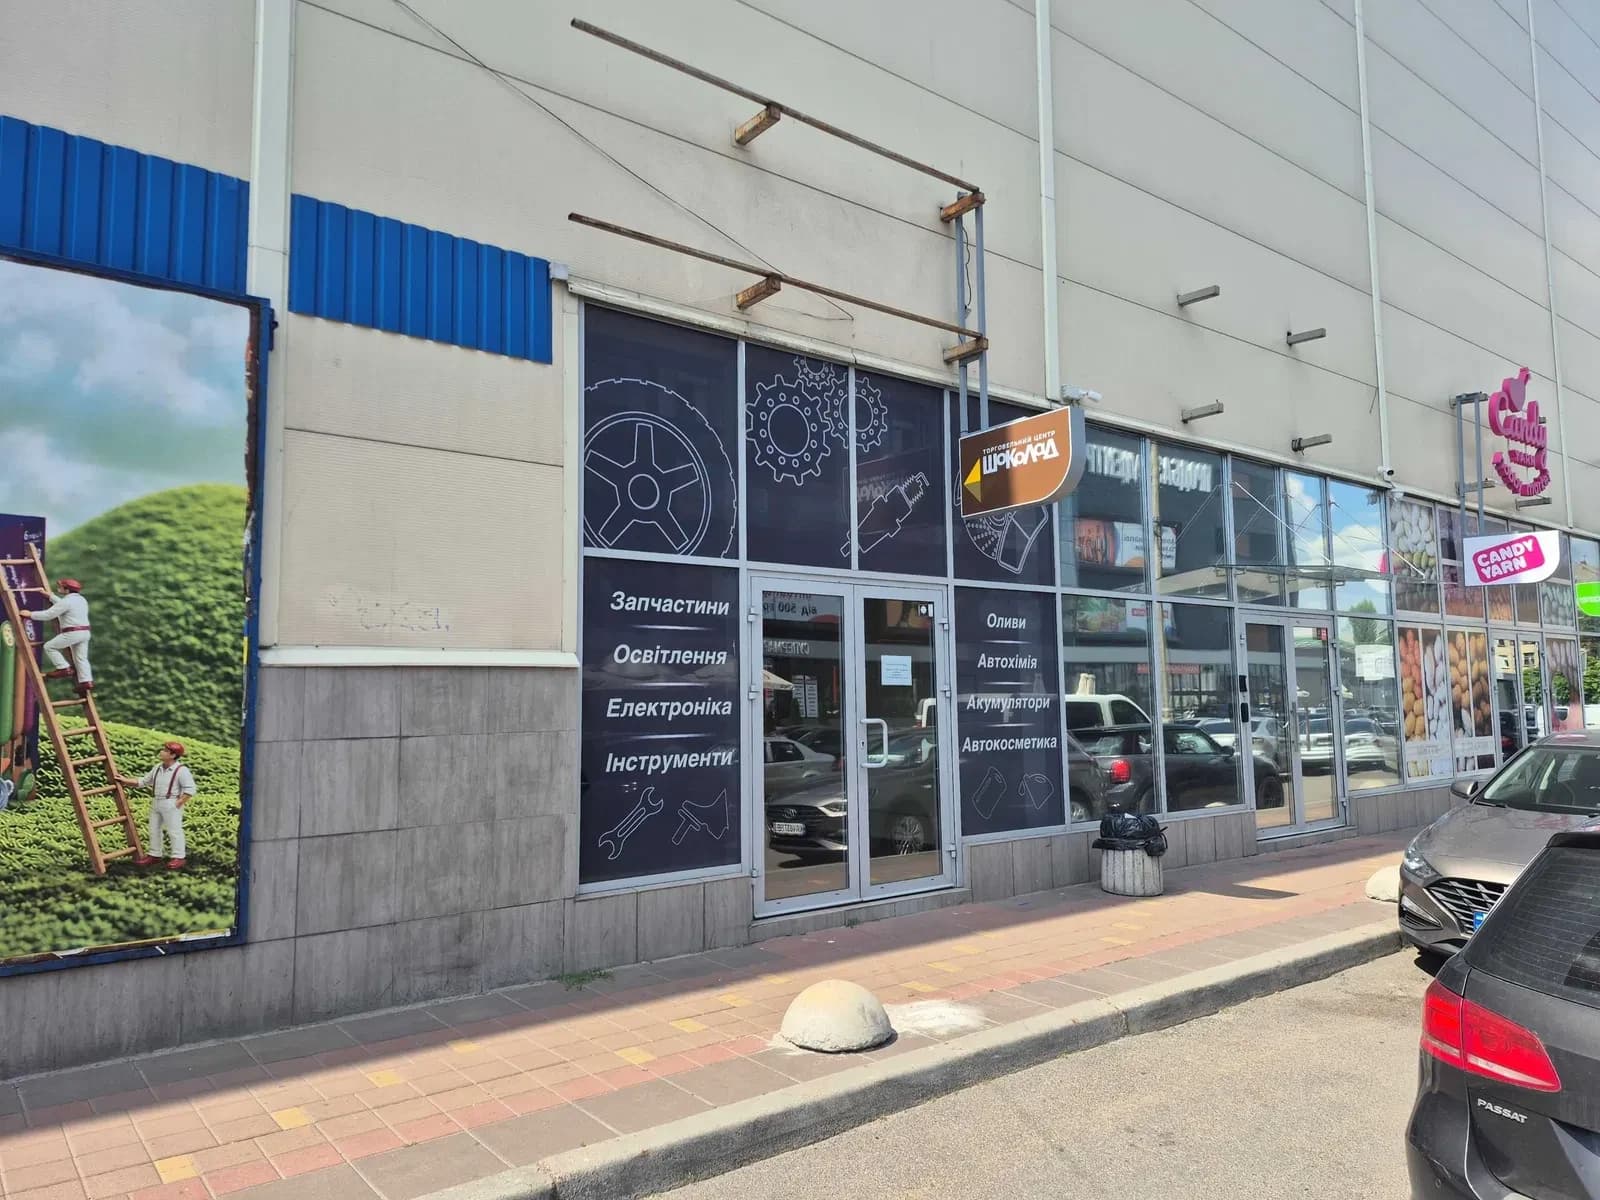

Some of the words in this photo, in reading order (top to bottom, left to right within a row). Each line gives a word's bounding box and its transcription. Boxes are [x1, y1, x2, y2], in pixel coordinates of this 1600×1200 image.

[1033, 430, 1056, 441] ЦЕНТР
[1477, 539, 1534, 567] CANDY
[1481, 556, 1527, 579] YARN
[610, 591, 730, 616] Запчастини
[987, 612, 1026, 630] Оливи
[613, 643, 728, 665] Освітлення
[977, 653, 1038, 669] Автохімія
[606, 697, 733, 721] Електроніка
[966, 694, 1051, 713] Акумулятори
[961, 736, 1058, 753] Автокосметика
[605, 752, 733, 775] Інструменти
[1477, 1098, 1528, 1123] PASSAT
